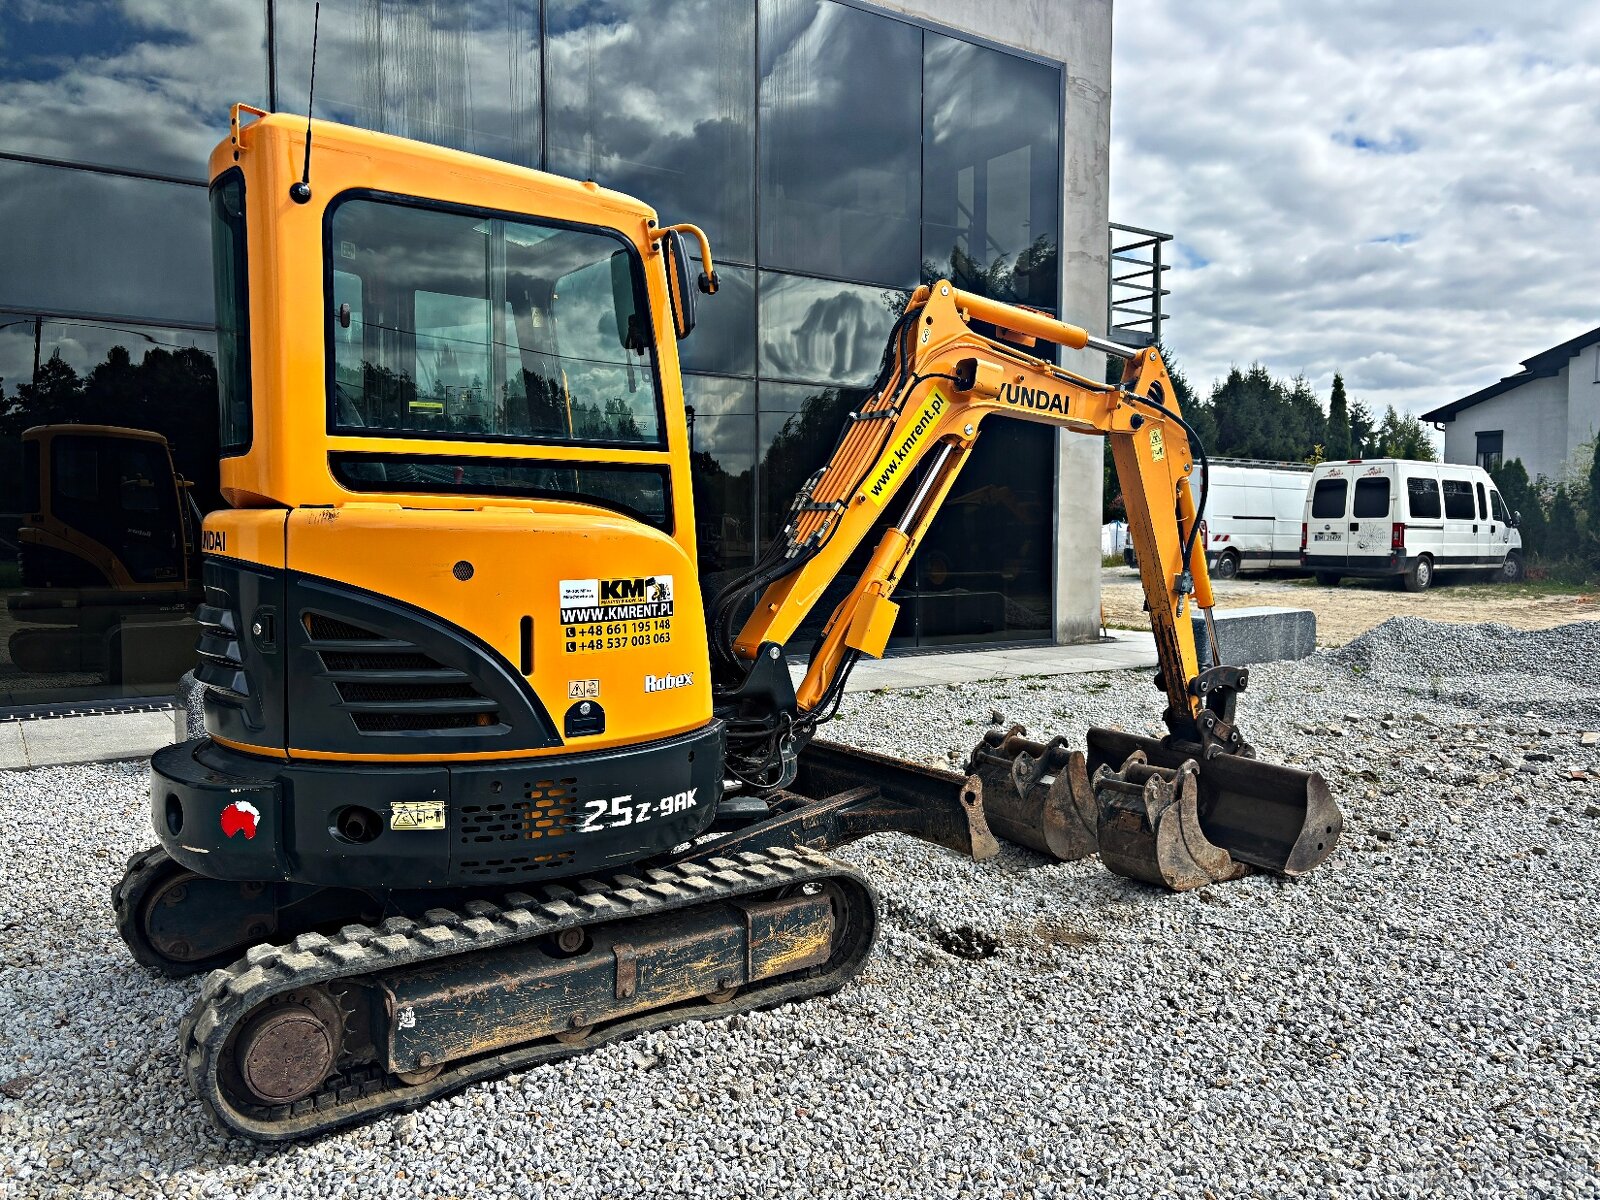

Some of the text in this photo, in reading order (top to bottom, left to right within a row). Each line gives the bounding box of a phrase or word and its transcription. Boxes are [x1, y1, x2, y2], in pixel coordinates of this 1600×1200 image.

[996, 383, 1070, 414] YUNDAI
[870, 392, 944, 498] www.kmrent.pl
[601, 579, 645, 599] KM
[562, 602, 673, 623] WWW.KMRENT.PL
[579, 619, 671, 637] +48 661 195 148
[579, 633, 671, 651] +48 537 003 063
[645, 672, 694, 693] Robex
